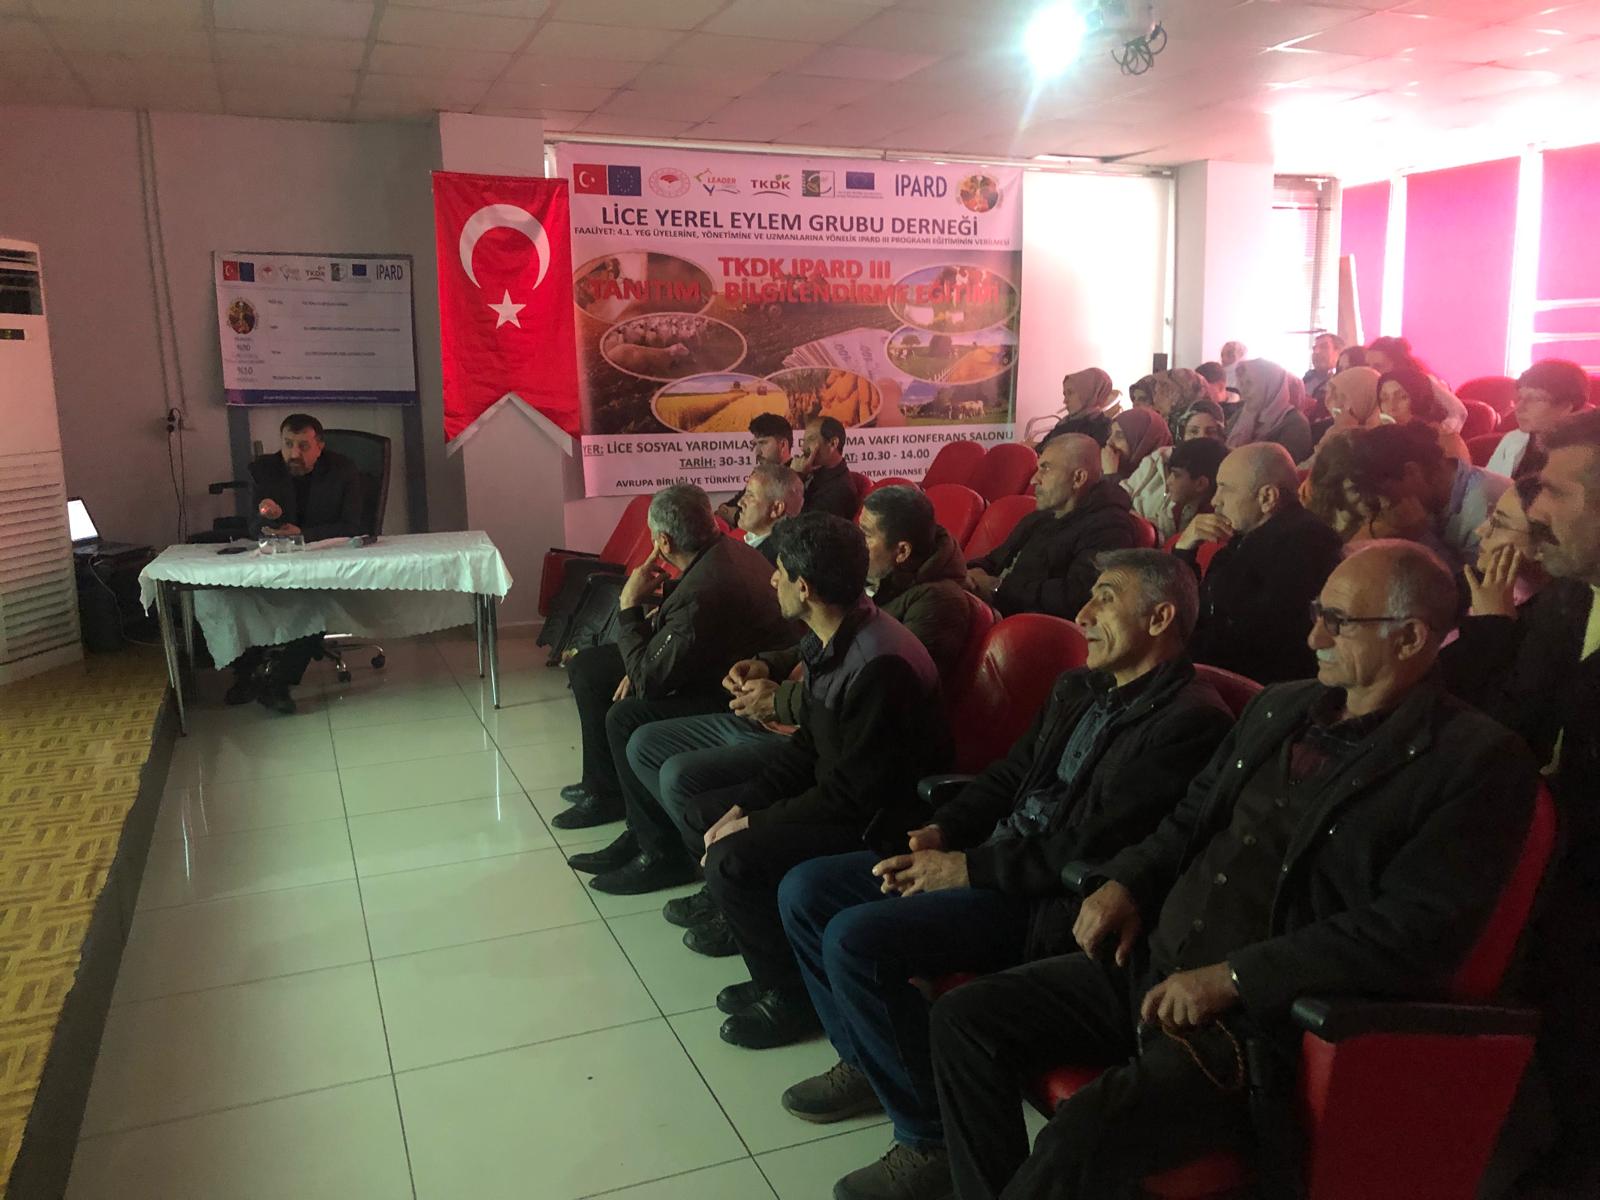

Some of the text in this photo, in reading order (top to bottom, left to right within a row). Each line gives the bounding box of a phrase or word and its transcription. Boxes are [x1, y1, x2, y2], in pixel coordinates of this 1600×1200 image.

[707, 176, 736, 185] LEADER
[750, 179, 791, 190] TKDK
[895, 174, 947, 198] IPARD
[601, 203, 978, 236] LİCE YEREL EYLEM GRUBU DERNEĞİ
[574, 226, 616, 236] FAALİYET:
[617, 228, 633, 236] 4.1.
[635, 229, 651, 237] YEG
[653, 229, 700, 239] ÜYELERİNE,
[701, 230, 752, 240] YÖNETİMİNE
[766, 232, 824, 242] UZMANLARINA
[825, 234, 857, 243] YÖNELİK
[858, 235, 881, 243] IPARD
[882, 236, 890, 244] III
[891, 236, 931, 245] PROGRAMI
[376, 264, 403, 280] IPARD
[718, 257, 891, 279] TKDK IPARD III
[588, 278, 701, 302] TANITIM
[724, 278, 909, 304] BİLGİLENDİRME
[915, 280, 1000, 304] EĞİTİMİ
[583, 444, 604, 456] YER:
[607, 440, 633, 454] LİCE
[636, 441, 683, 453] SOSYAL
[685, 438, 757, 452] YARDIMLAŞ
[866, 435, 900, 446] VAKFI
[902, 433, 967, 445] KONFERANS
[969, 431, 1014, 442] SALONU
[679, 456, 716, 469] TARİH:
[719, 455, 751, 467] 30-31
[844, 453, 858, 463] AT:
[861, 451, 891, 461] 10.30
[900, 449, 930, 459] 14.00
[616, 479, 654, 488] AVRUPA
[690, 477, 702, 485] VE
[704, 474, 740, 485] TÜRKİYE
[889, 467, 922, 476] FİNANSE
